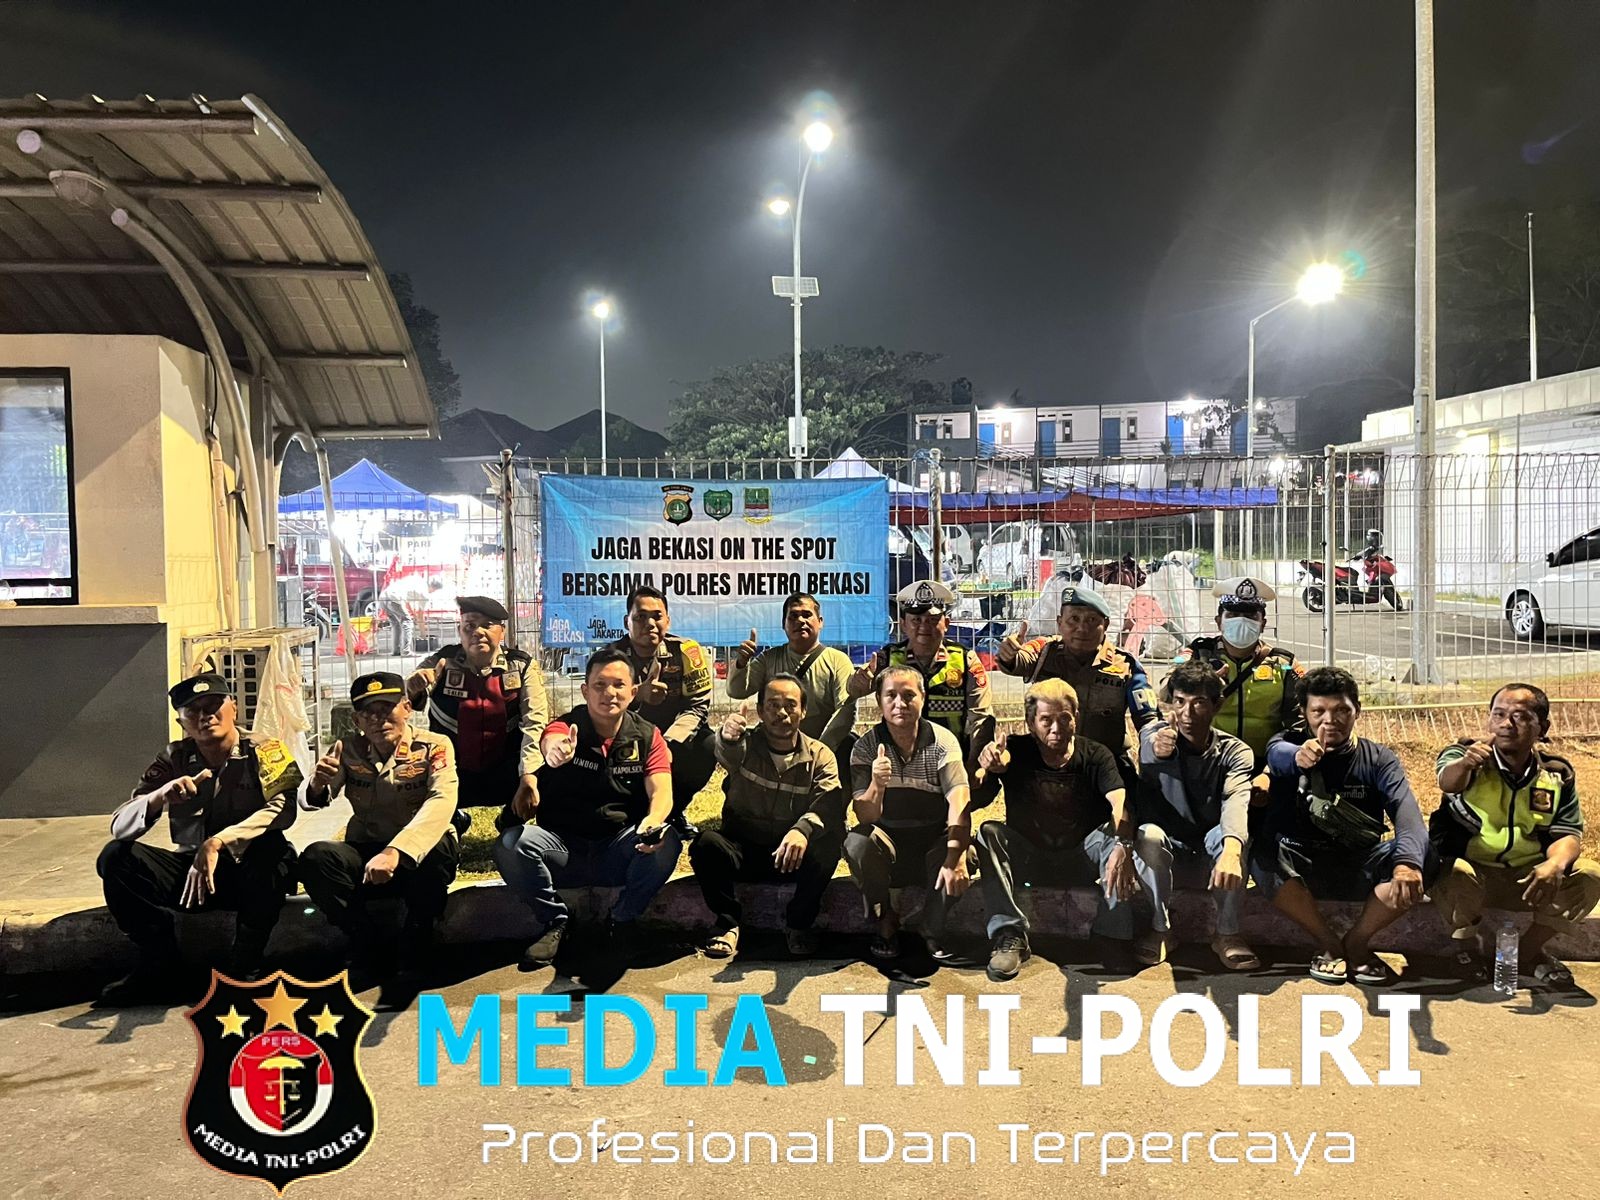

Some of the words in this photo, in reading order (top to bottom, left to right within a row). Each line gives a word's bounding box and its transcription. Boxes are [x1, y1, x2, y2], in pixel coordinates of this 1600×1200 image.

[591, 537, 642, 560] JAGA
[649, 537, 714, 560] BEKASI
[720, 537, 747, 560] ON
[752, 537, 786, 560] THE
[791, 537, 837, 560] SPOT
[561, 572, 654, 596] BERSAMA
[662, 572, 731, 595] POLRES
[738, 572, 800, 596] METRO
[807, 572, 870, 595] BEKASI
[546, 618, 570, 631] JAGA
[587, 618, 607, 630] JAGA
[552, 630, 585, 643] BEKASI
[592, 629, 625, 639] JAKARTA
